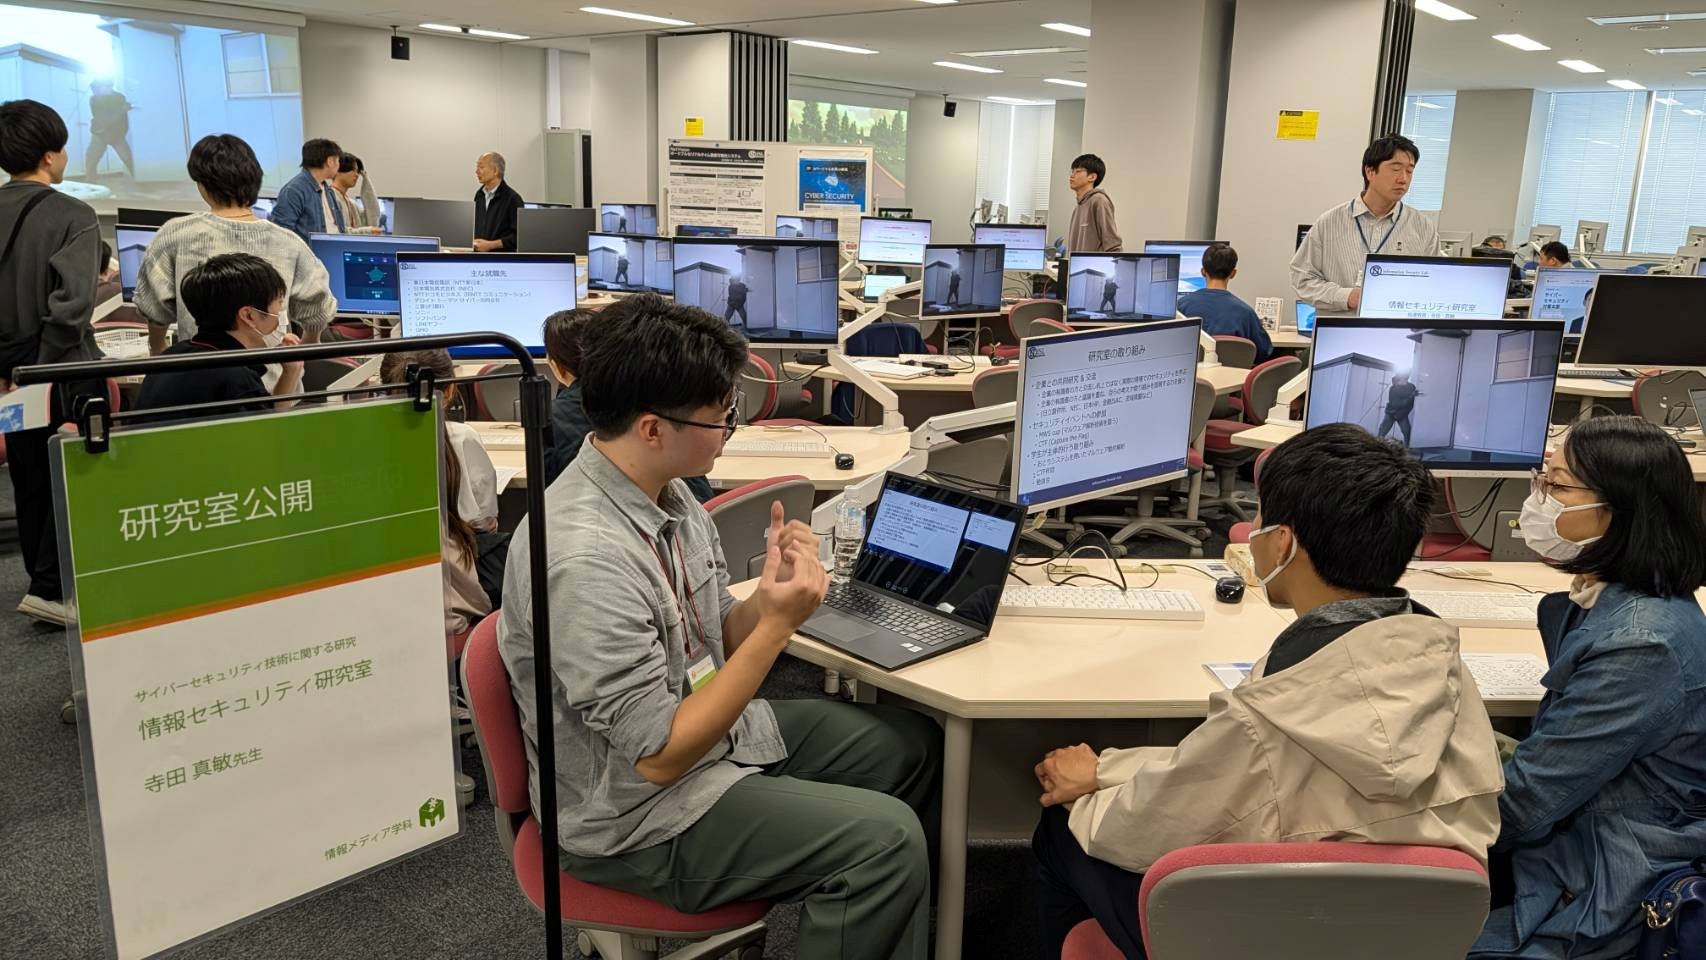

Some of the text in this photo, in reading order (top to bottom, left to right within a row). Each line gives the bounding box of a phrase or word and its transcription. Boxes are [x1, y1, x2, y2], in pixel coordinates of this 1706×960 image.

[1388, 300, 1477, 312] 情報セキュリティ研究室
[1088, 344, 1146, 362] 研究室の取り組み
[118, 479, 314, 543] 研究室公開
[134, 635, 357, 703] サイバーセキュリティ技術に関する研究
[138, 658, 373, 742] 情報セキュリティ研究室
[144, 747, 263, 794] 寺田 真敏先生
[324, 817, 413, 861] 情報メディア学科
